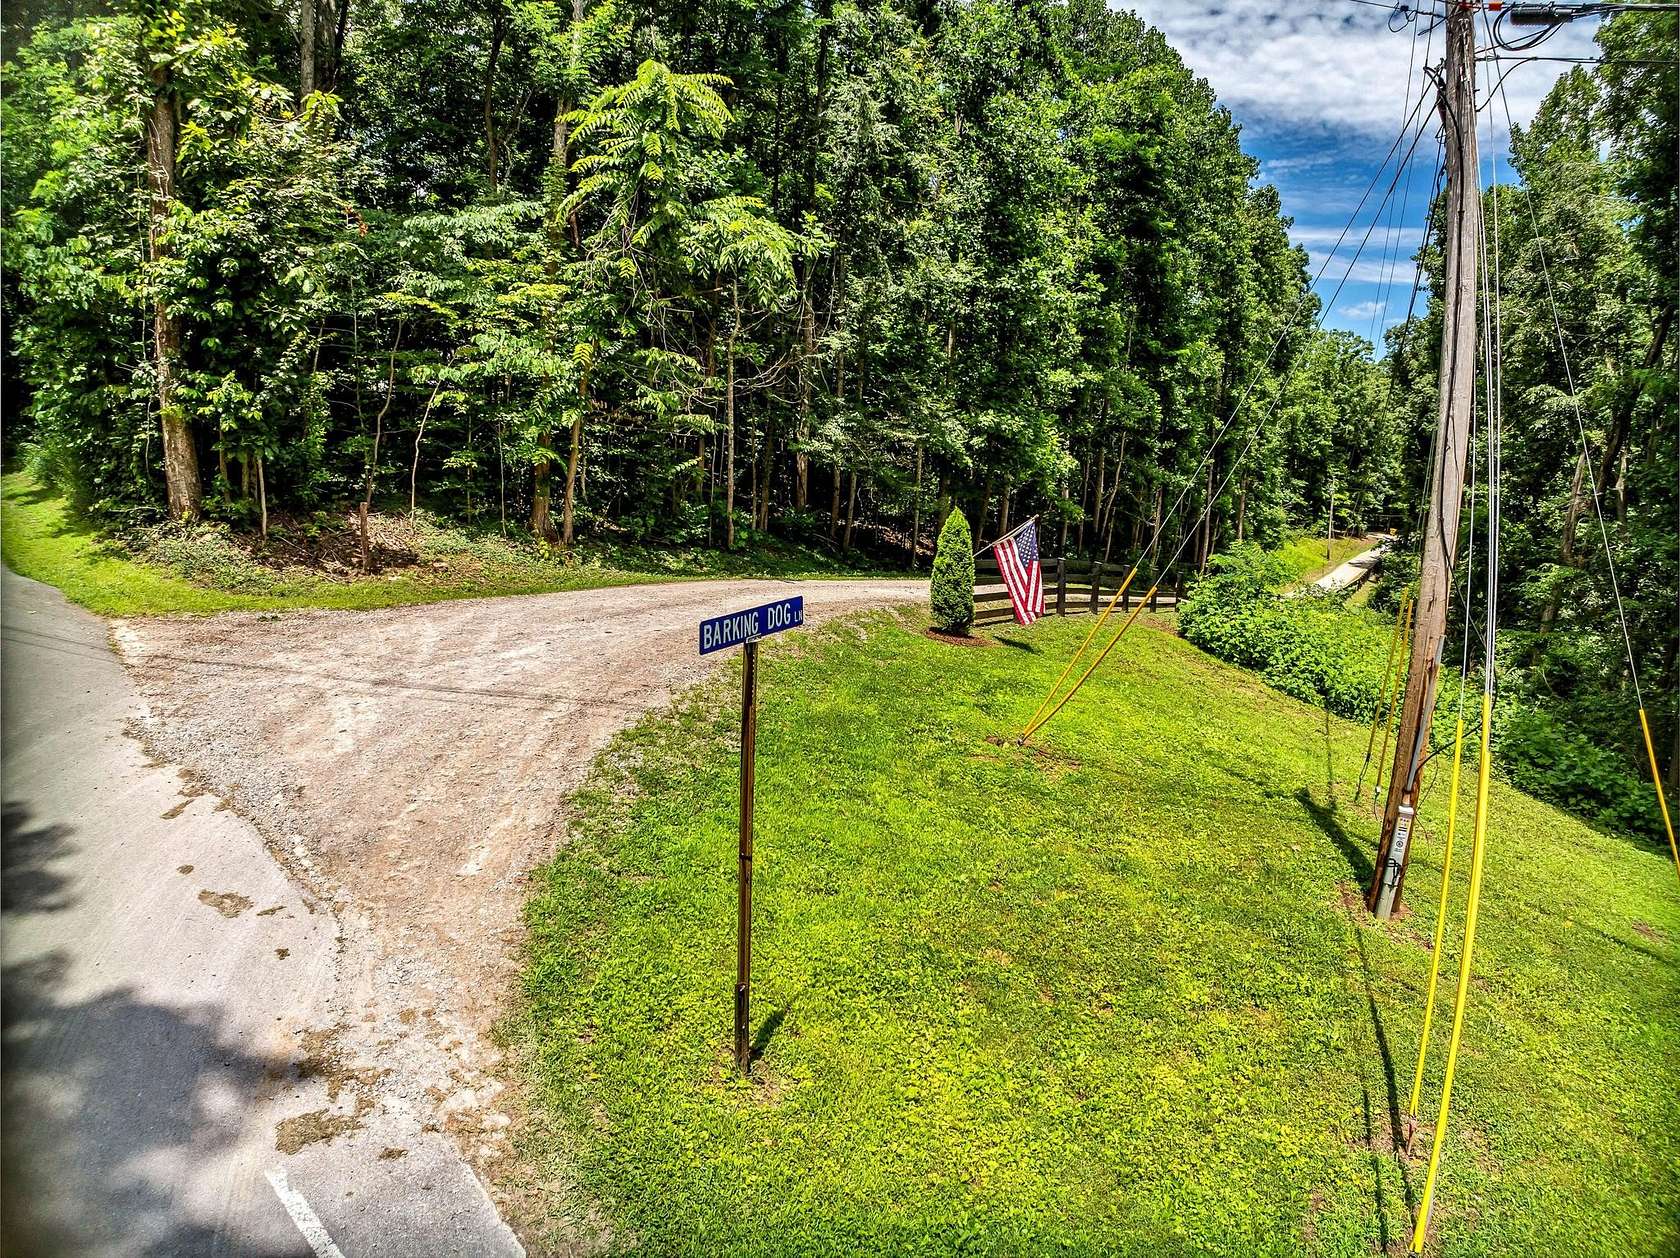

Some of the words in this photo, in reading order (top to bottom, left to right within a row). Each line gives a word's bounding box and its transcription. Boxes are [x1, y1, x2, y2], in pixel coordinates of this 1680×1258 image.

[704, 612, 759, 649] BARKING
[768, 603, 791, 629] DOG
[794, 610, 803, 622] LN
